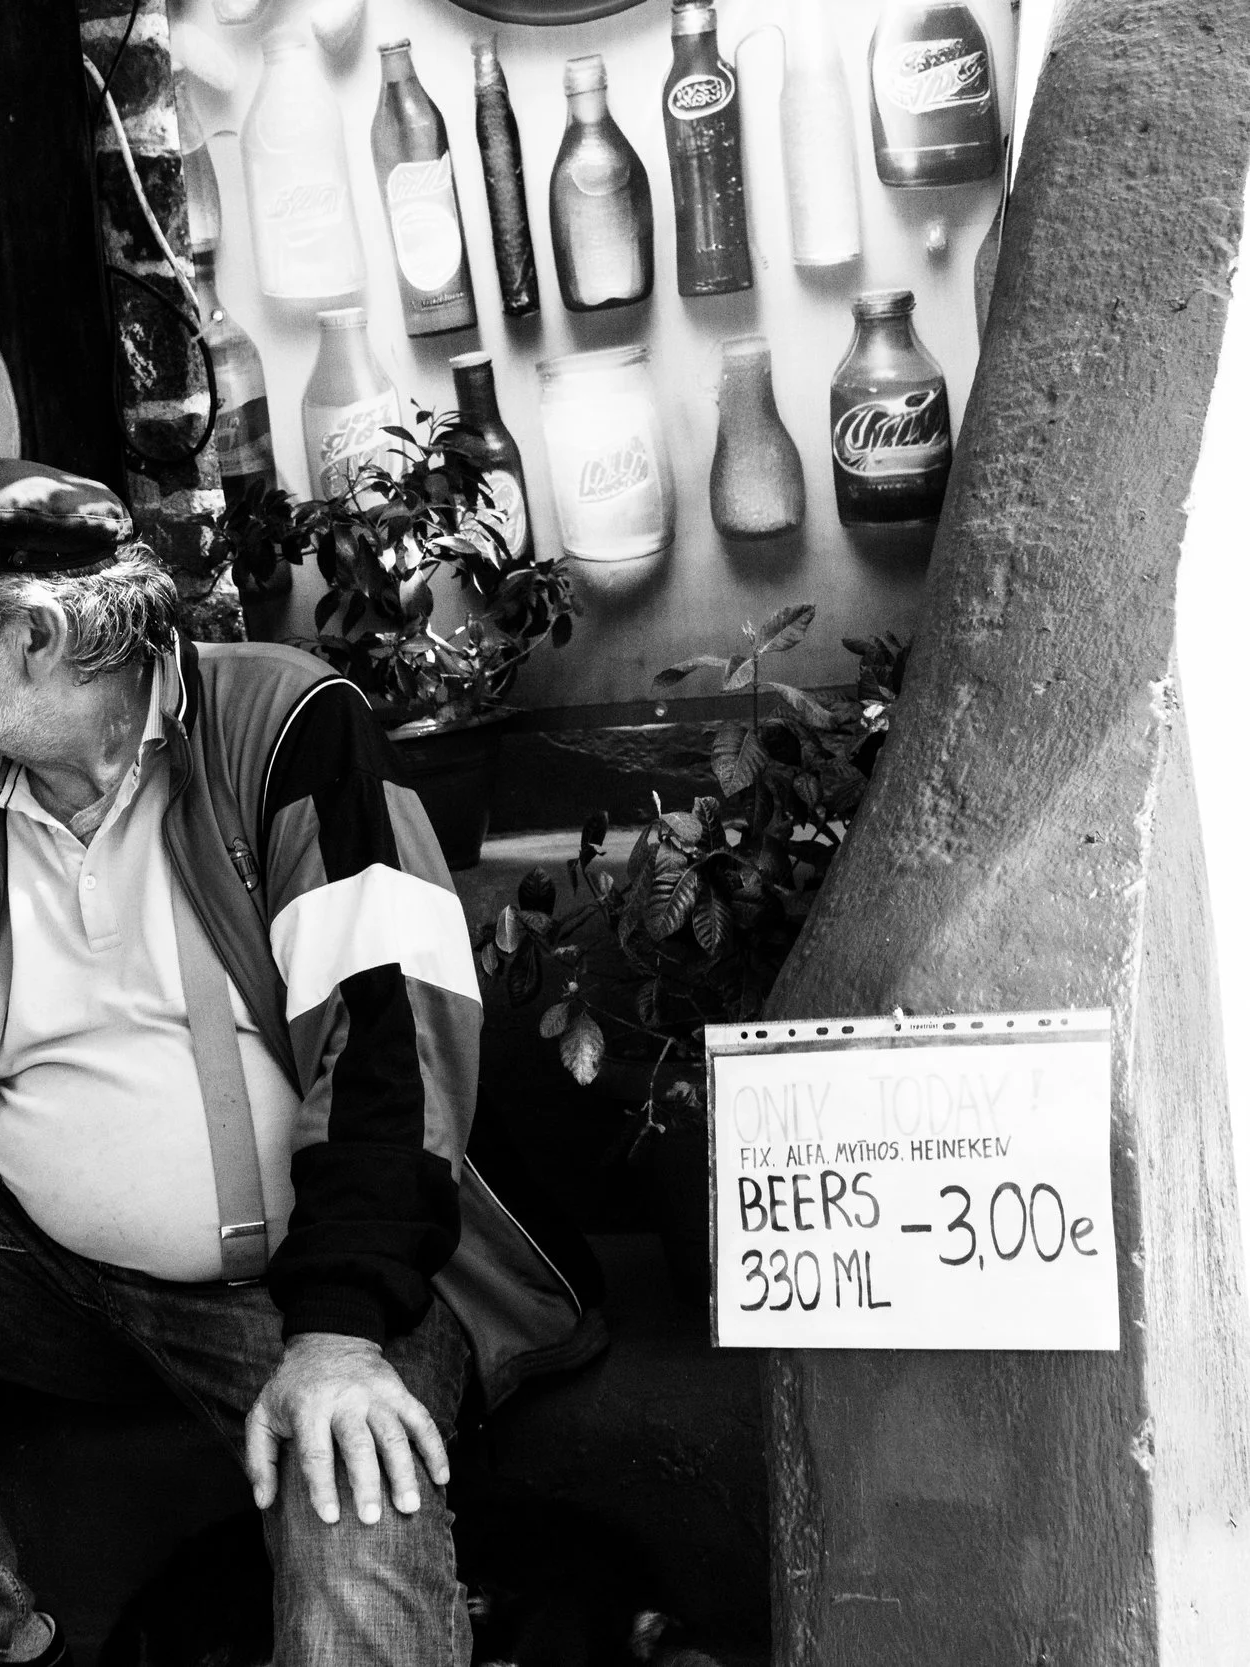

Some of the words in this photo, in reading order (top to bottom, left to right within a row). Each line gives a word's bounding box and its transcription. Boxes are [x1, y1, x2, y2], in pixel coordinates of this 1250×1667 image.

[733, 1081, 831, 1143] ONLY
[868, 1070, 1010, 1138] TODAY
[911, 1135, 1012, 1162] HEINEKEN
[738, 1170, 880, 1232] BEERS
[739, 1249, 821, 1311] 330
[833, 1249, 892, 1309] ML
